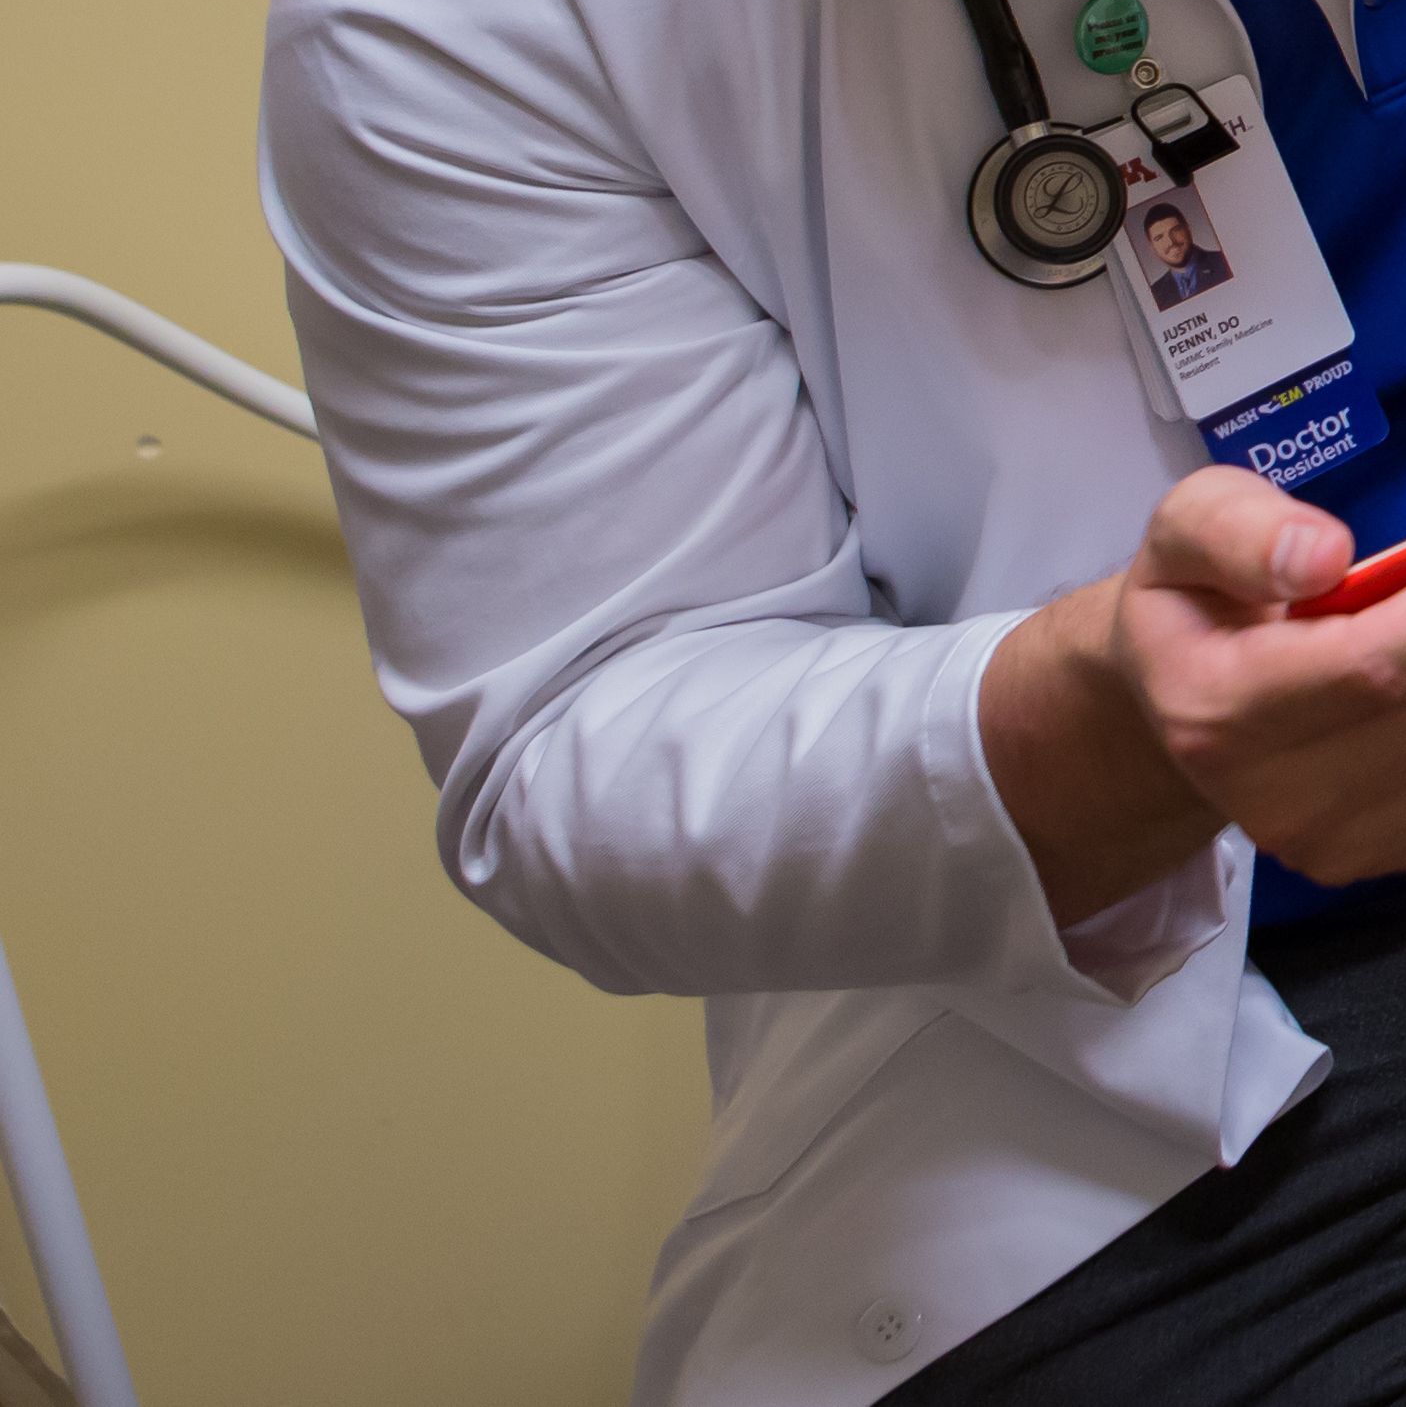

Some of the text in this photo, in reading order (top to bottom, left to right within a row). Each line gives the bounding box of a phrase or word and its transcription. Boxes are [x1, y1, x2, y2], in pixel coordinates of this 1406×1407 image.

[1162, 312, 1208, 343] JUSTIN
[1168, 315, 1240, 358] PENNY, DO
[1206, 336, 1233, 355] Family
[1234, 318, 1273, 341] Medicine
[1179, 356, 1221, 381] Resident
[1213, 407, 1260, 440] WASH
[1303, 360, 1353, 394] PROUD
[1247, 406, 1350, 475] Doctor
[1267, 434, 1357, 488] Resident
